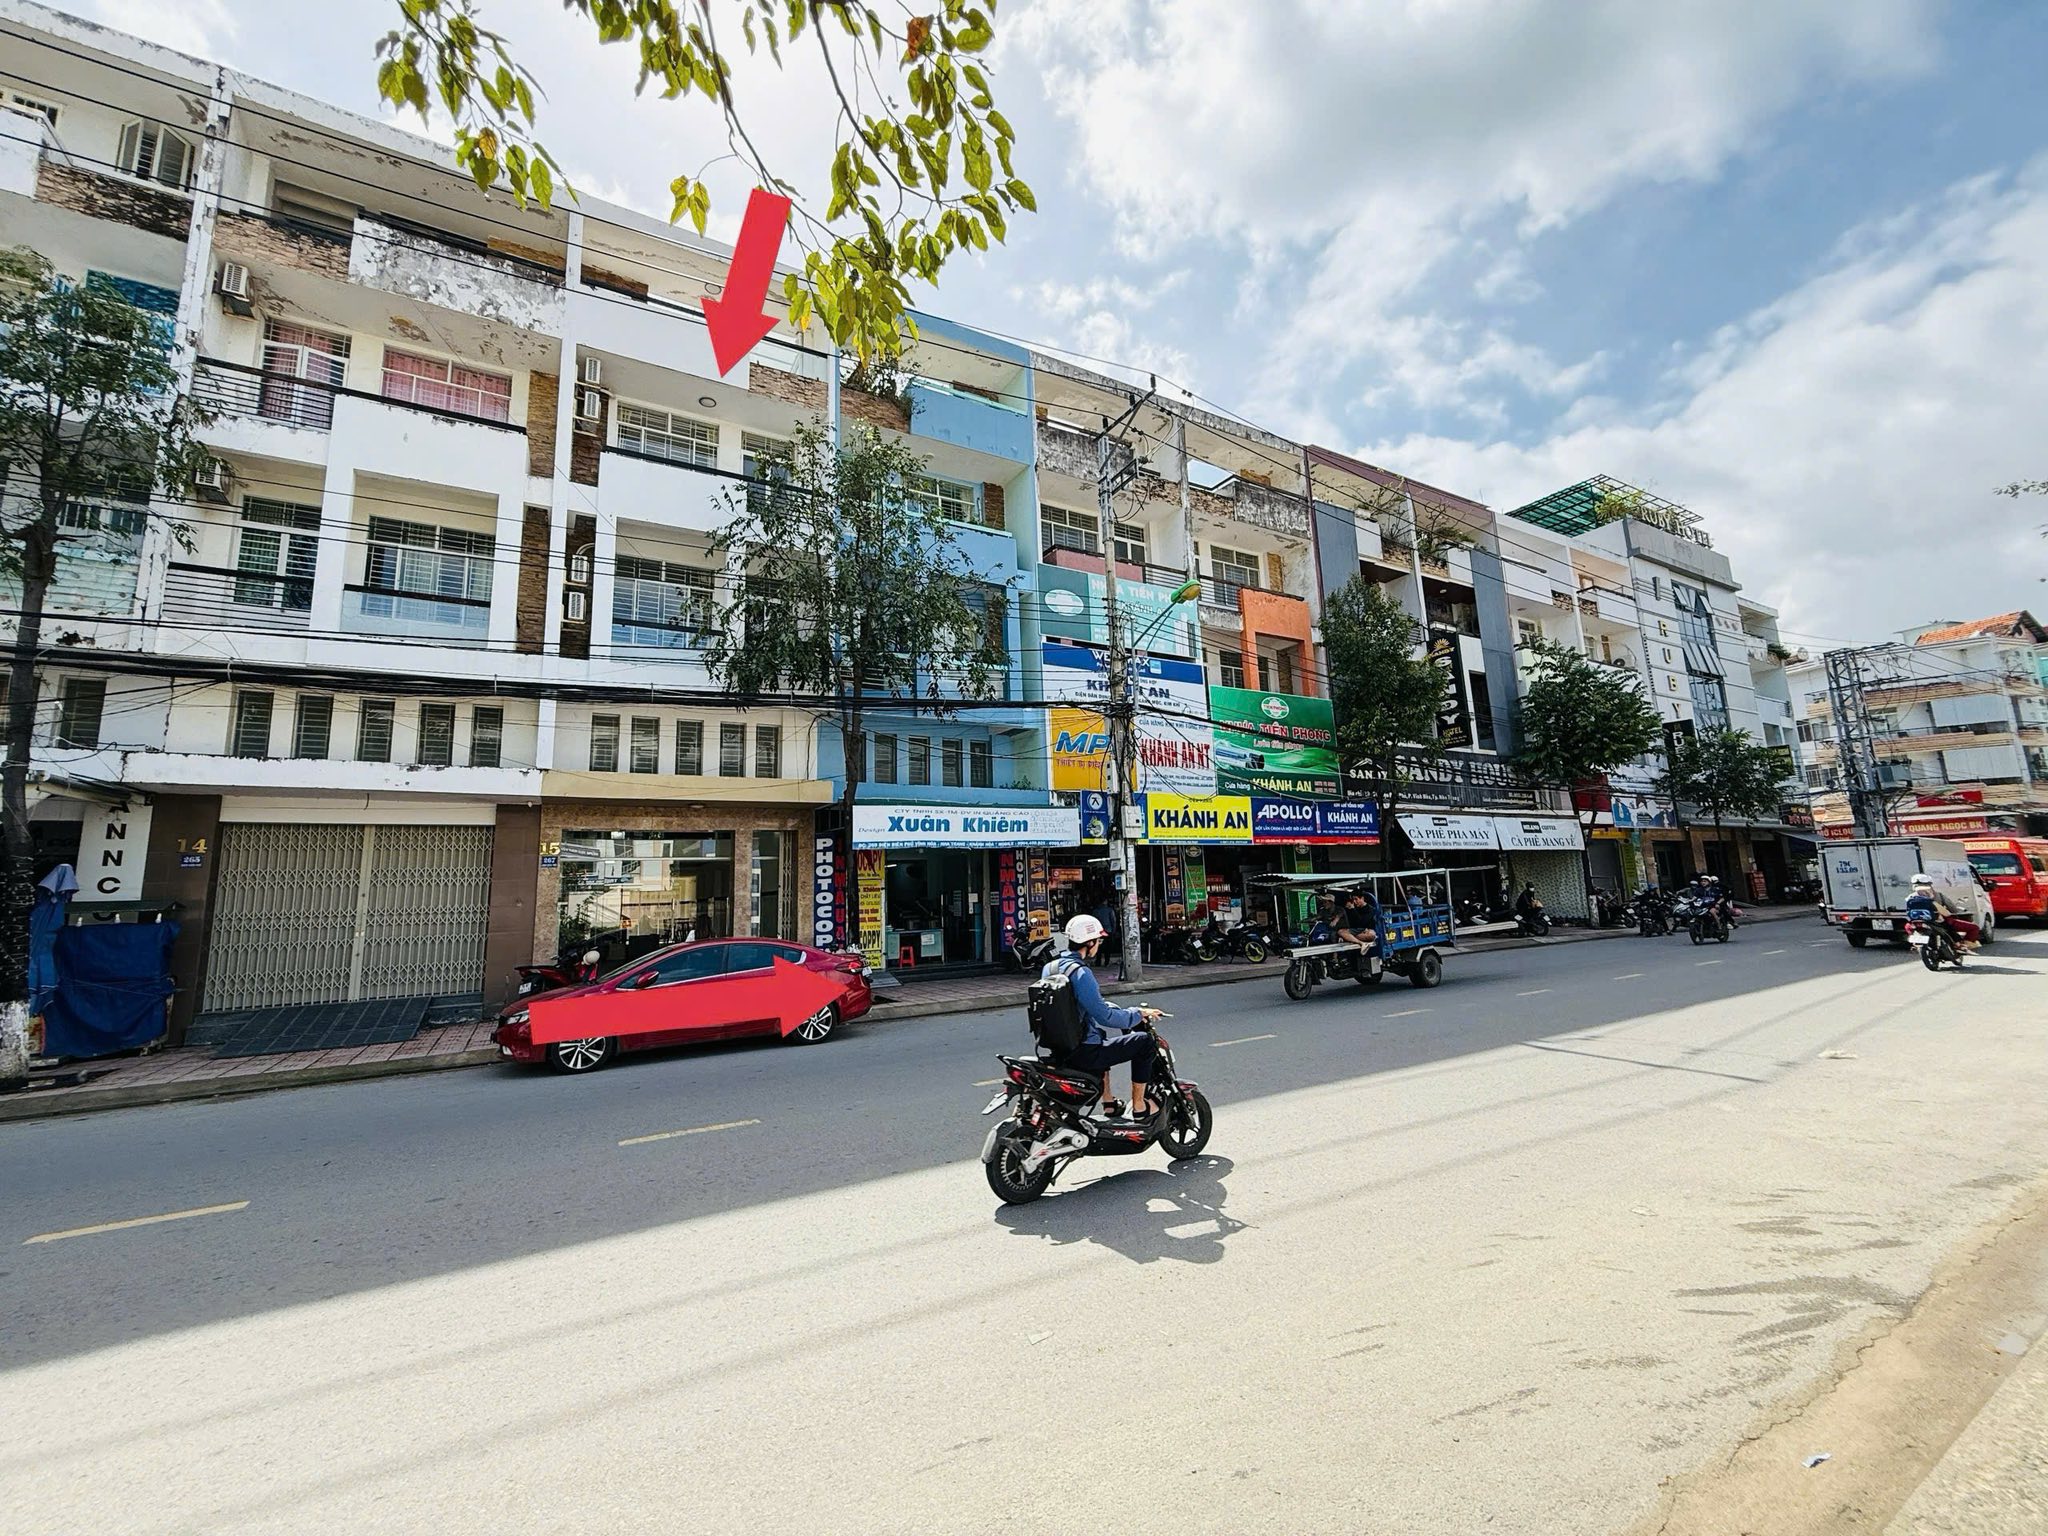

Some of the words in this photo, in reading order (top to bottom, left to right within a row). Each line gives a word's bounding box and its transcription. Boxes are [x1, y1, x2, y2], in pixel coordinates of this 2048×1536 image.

[1091, 579, 1124, 596] NHA
[1657, 620, 1682, 719] RUBY
[1149, 686, 1170, 699] AN
[1292, 726, 1332, 743] PHONG
[1141, 733, 1178, 768] KHÁNH
[1182, 740, 1195, 769] AN
[1197, 743, 1211, 770] NT
[1350, 768, 1388, 780] SANY
[1469, 761, 1519, 787] HOUS
[1252, 776, 1293, 792] KHÁNH
[1296, 780, 1313, 793] AN
[1153, 804, 1218, 829] KHÁNH
[1223, 811, 1249, 829] AN
[1257, 804, 1313, 820] APOLLO
[1327, 810, 1358, 823] KHÁNH
[1360, 813, 1373, 823] AN
[888, 815, 950, 833] Xuân
[962, 816, 1029, 833] Khiêm
[1908, 823, 1939, 833] QUANG
[1941, 821, 1968, 834] NGỌC
[1969, 820, 1982, 829] BK
[1409, 828, 1424, 839] CÀ
[1426, 827, 1445, 839] PHÊ
[1447, 829, 1468, 839] PHA
[1469, 828, 1490, 839] MÁY
[1511, 834, 1524, 847] CÀ
[1523, 834, 1541, 847] PHÊ
[1541, 837, 1565, 847] MANG
[1565, 834, 1577, 847] VỀ
[1830, 828, 1854, 837] ICLOU
[177, 838, 207, 853] 14
[540, 842, 560, 855] 15
[815, 838, 834, 949] PHOTOCOP
